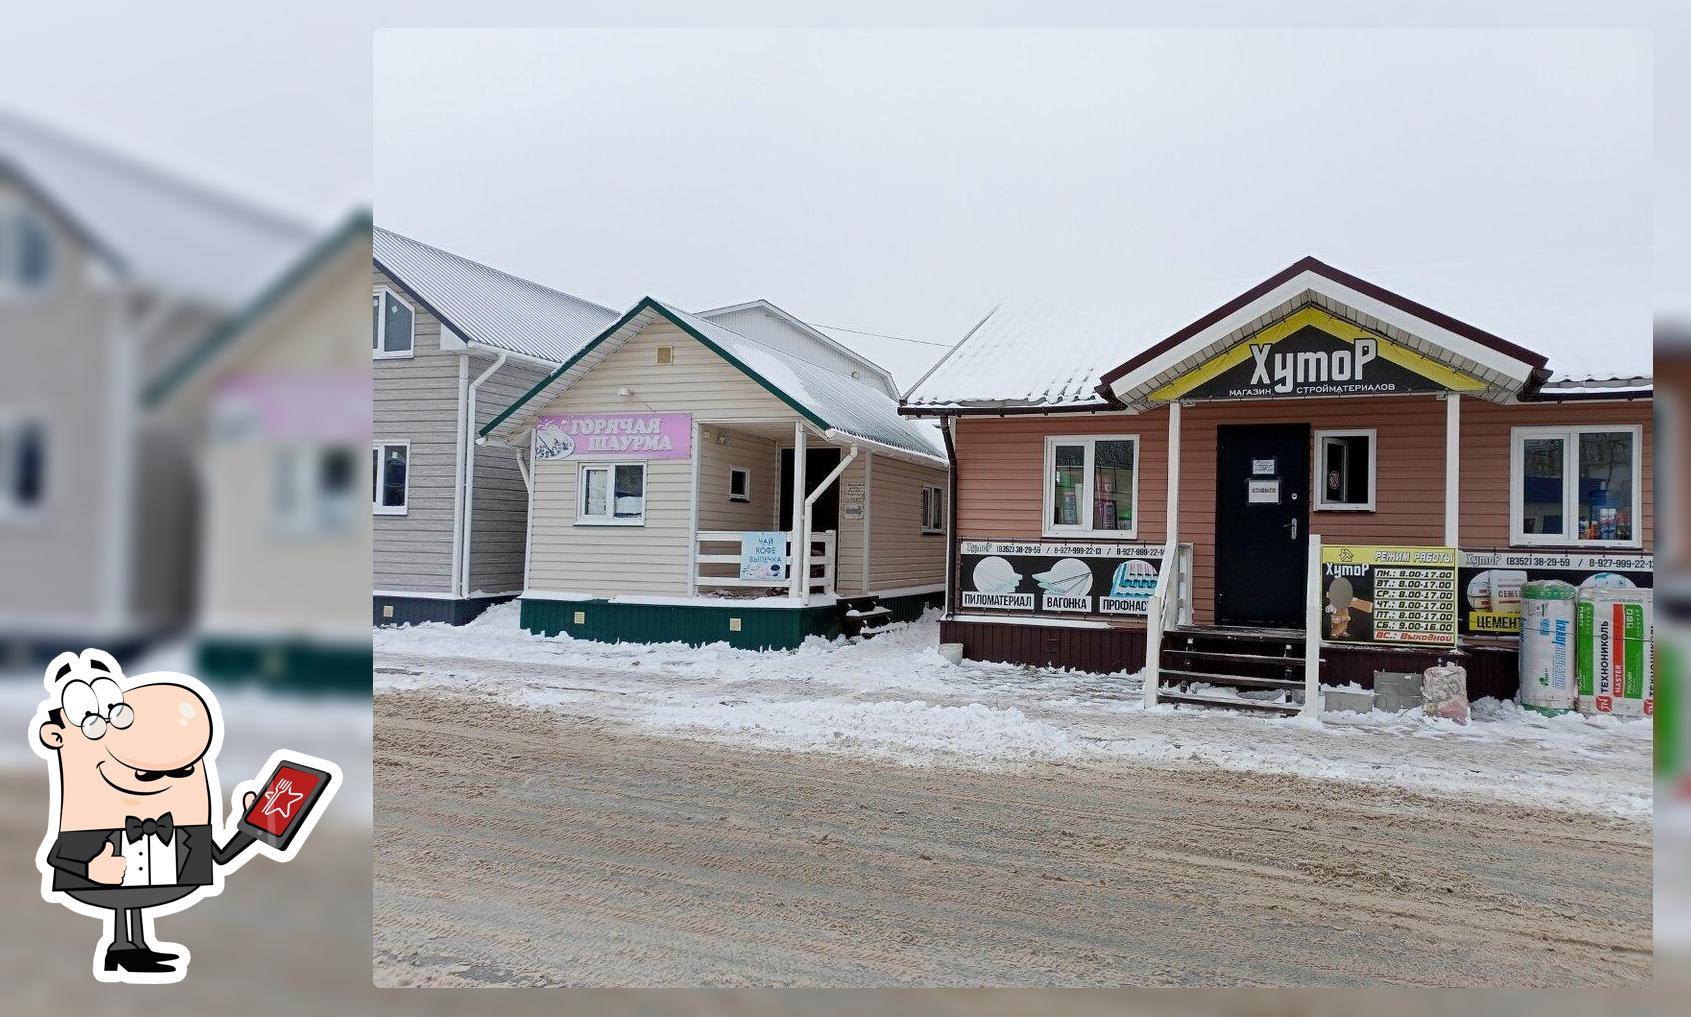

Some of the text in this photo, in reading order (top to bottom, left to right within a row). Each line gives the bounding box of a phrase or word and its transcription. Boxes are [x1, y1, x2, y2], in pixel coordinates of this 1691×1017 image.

[1229, 383, 1396, 396] МАГАЗИН СТРОЙМАТЕРИАЛОВ
[570, 418, 662, 435] ГОРЯЧАЯ
[589, 434, 673, 451] ШАУРМА
[758, 537, 774, 545] ЧАЙ
[755, 546, 776, 554] КОФЕ
[749, 555, 782, 563] ВЫПЕЧКА
[1375, 551, 1455, 563] РЕЖИМ РАБОТЫ
[1534, 557, 1570, 567] 38-29-59
[1589, 558, 1653, 568] 8-927-999-22-1
[1399, 570, 1452, 578] 8.00-17.00
[1398, 580, 1452, 589] 8.00-17.00
[1398, 590, 1453, 599] 8.00-17.00
[964, 593, 1032, 607] ПИЛОМАТЕРИАЛ
[1047, 597, 1087, 609] ВАГОНКА
[1103, 599, 1148, 611] ПРОФНАС
[1399, 601, 1453, 610] 8.00-17.00
[1399, 612, 1453, 620] 8.00-17.00
[1399, 622, 1453, 631] 9.00-16.00
[1400, 632, 1453, 641] Выходной
[1600, 620, 1609, 694] ТЕХНОНИКОЛЬ
